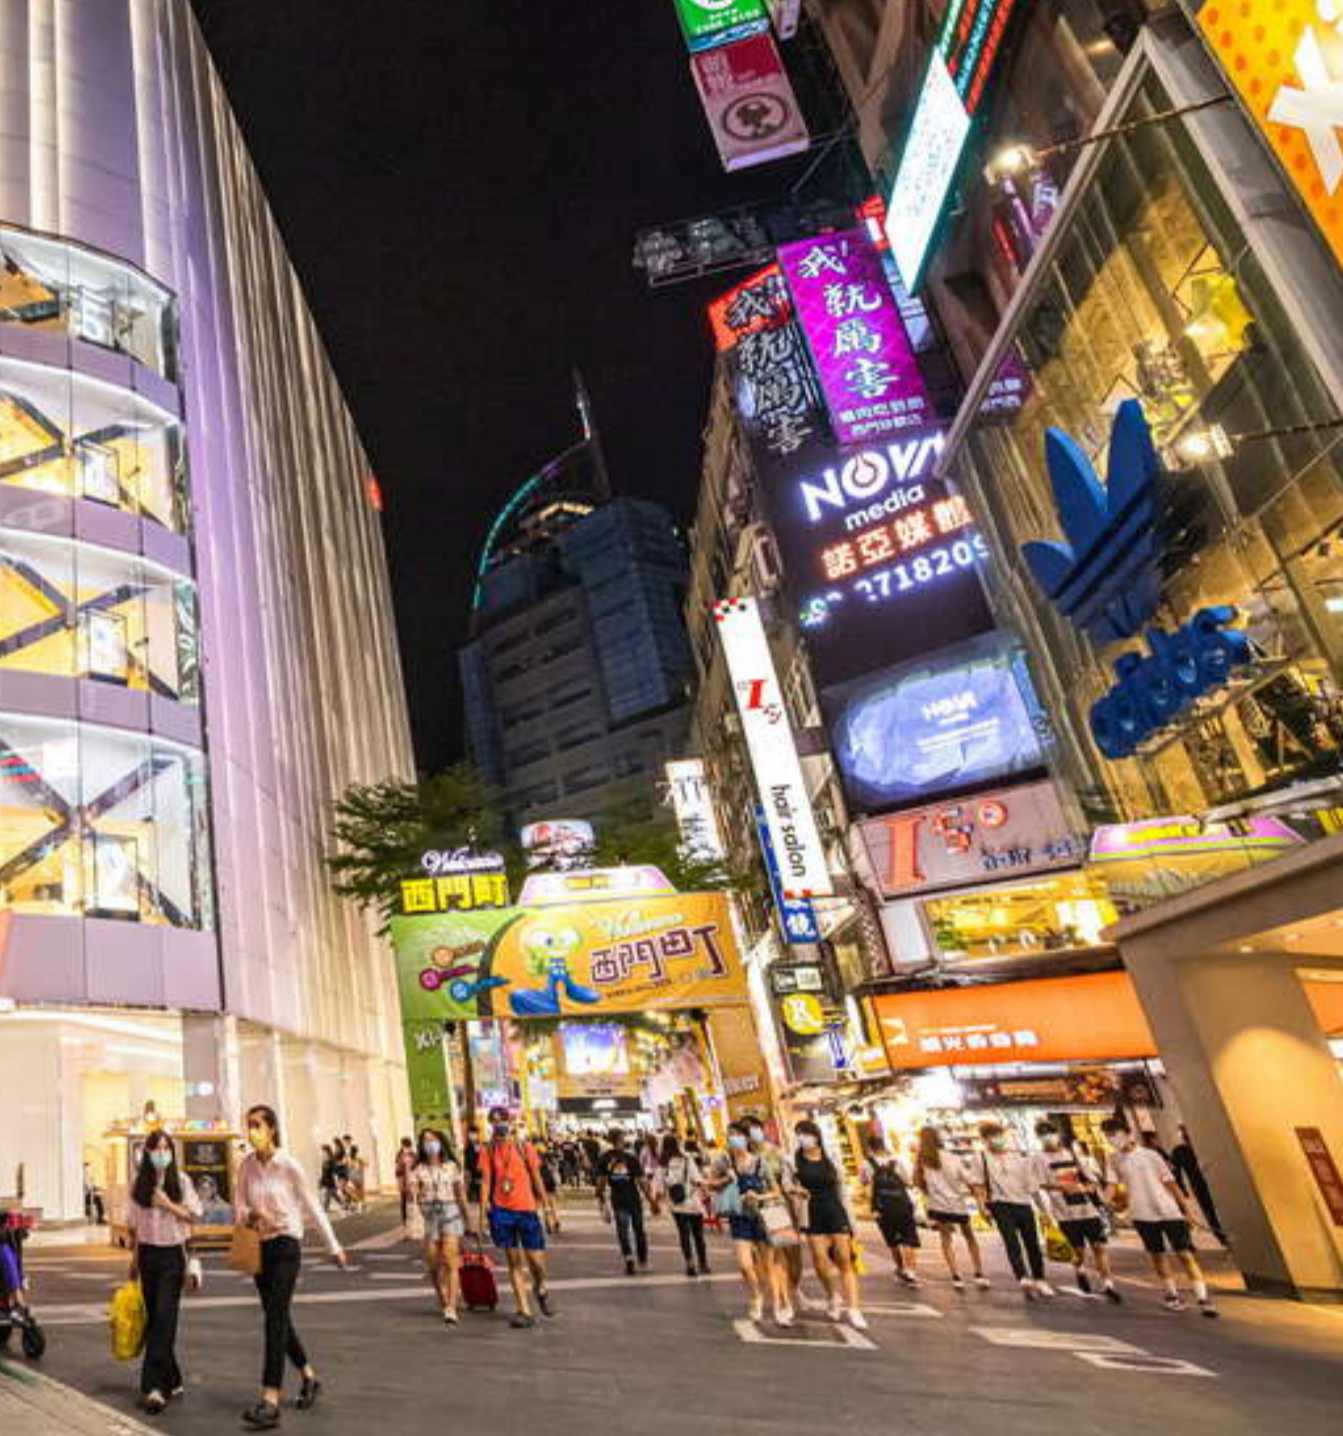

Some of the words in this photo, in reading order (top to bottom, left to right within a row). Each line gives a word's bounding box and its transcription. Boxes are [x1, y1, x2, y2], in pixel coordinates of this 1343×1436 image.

[844, 484, 925, 531] media
[770, 784, 799, 819] hair
[780, 824, 807, 878] salon
[401, 872, 507, 913] 西門町
